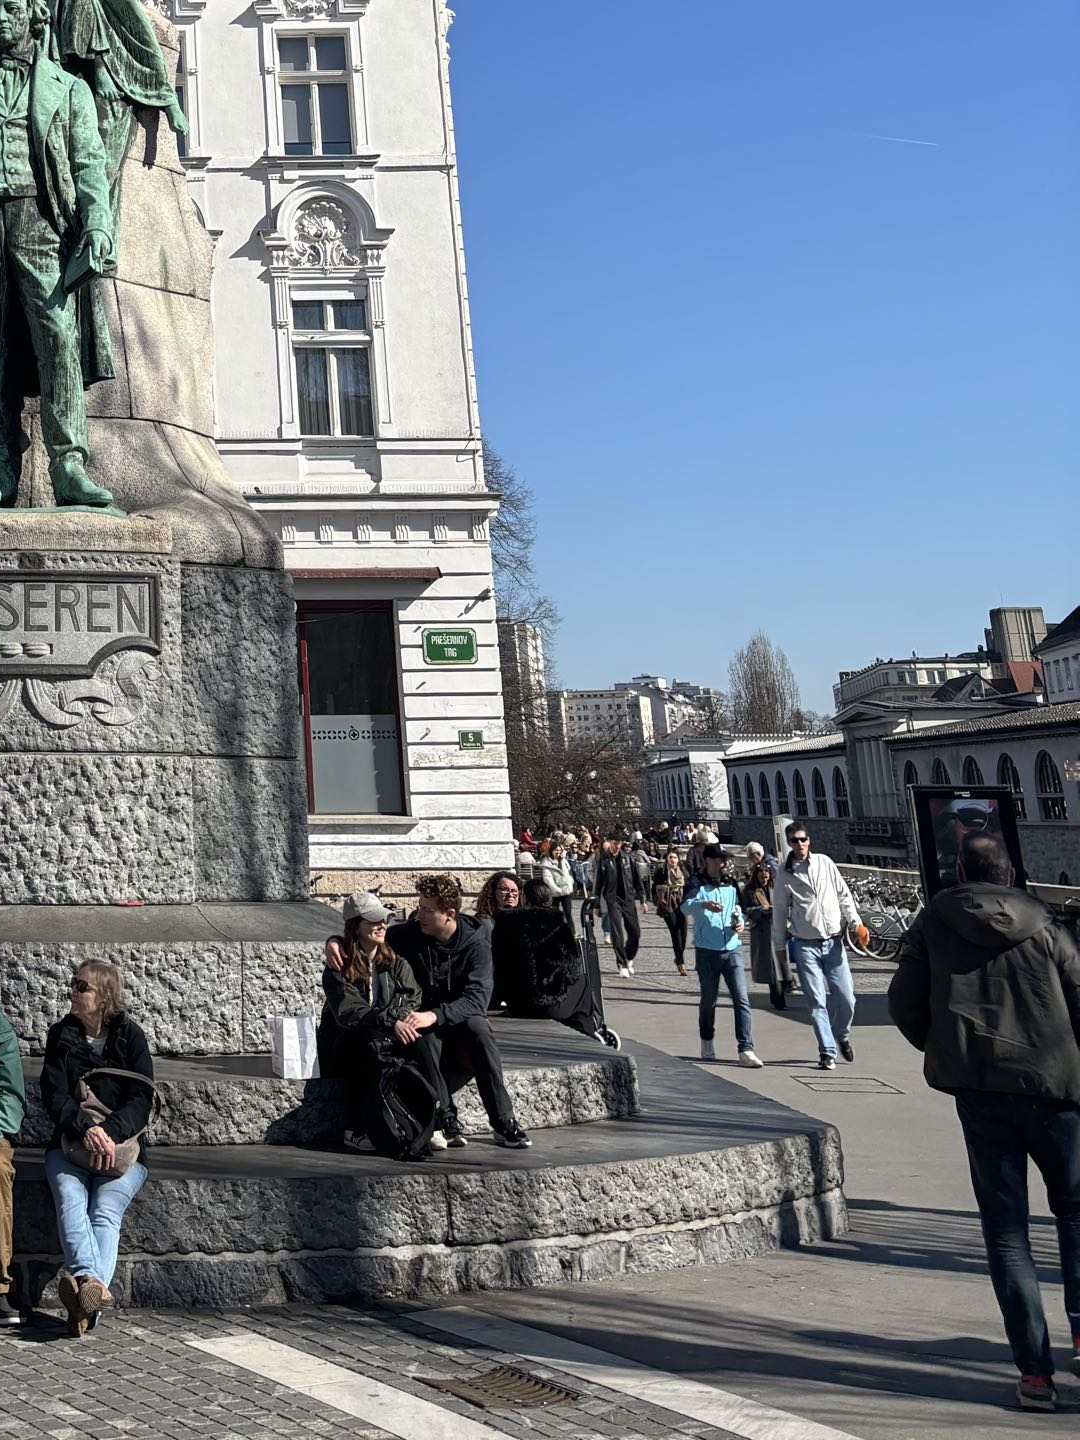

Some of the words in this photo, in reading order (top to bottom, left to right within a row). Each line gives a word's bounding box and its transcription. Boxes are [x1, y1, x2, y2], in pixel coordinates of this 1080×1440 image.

[431, 634, 468, 645] PREŠERNOV
[444, 648, 457, 657] TRG
[468, 733, 474, 742] 5
